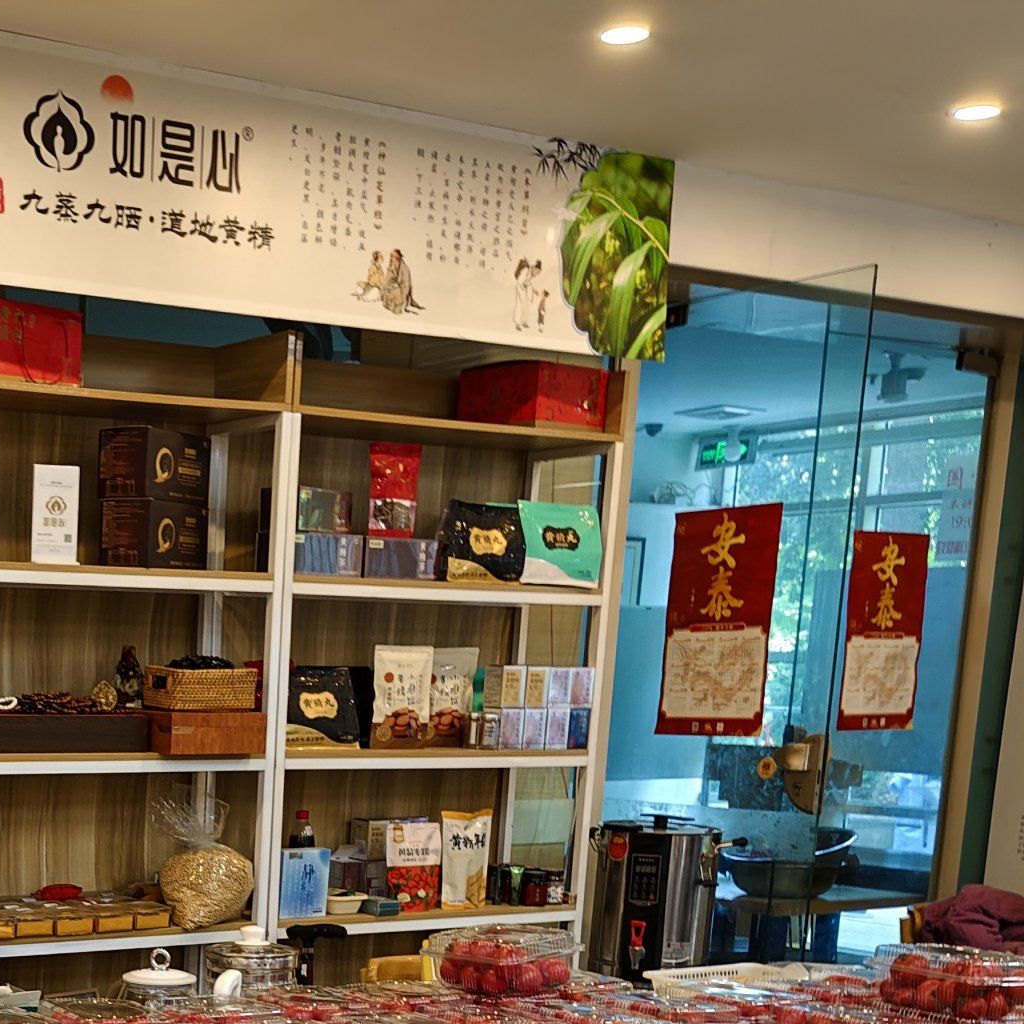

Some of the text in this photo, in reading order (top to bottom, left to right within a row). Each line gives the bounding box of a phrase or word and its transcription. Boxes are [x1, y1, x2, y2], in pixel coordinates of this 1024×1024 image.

[109, 111, 242, 195] 如是心
[18, 189, 275, 252] 九蒸九晒·道地黄精
[700, 513, 746, 621] 安泰
